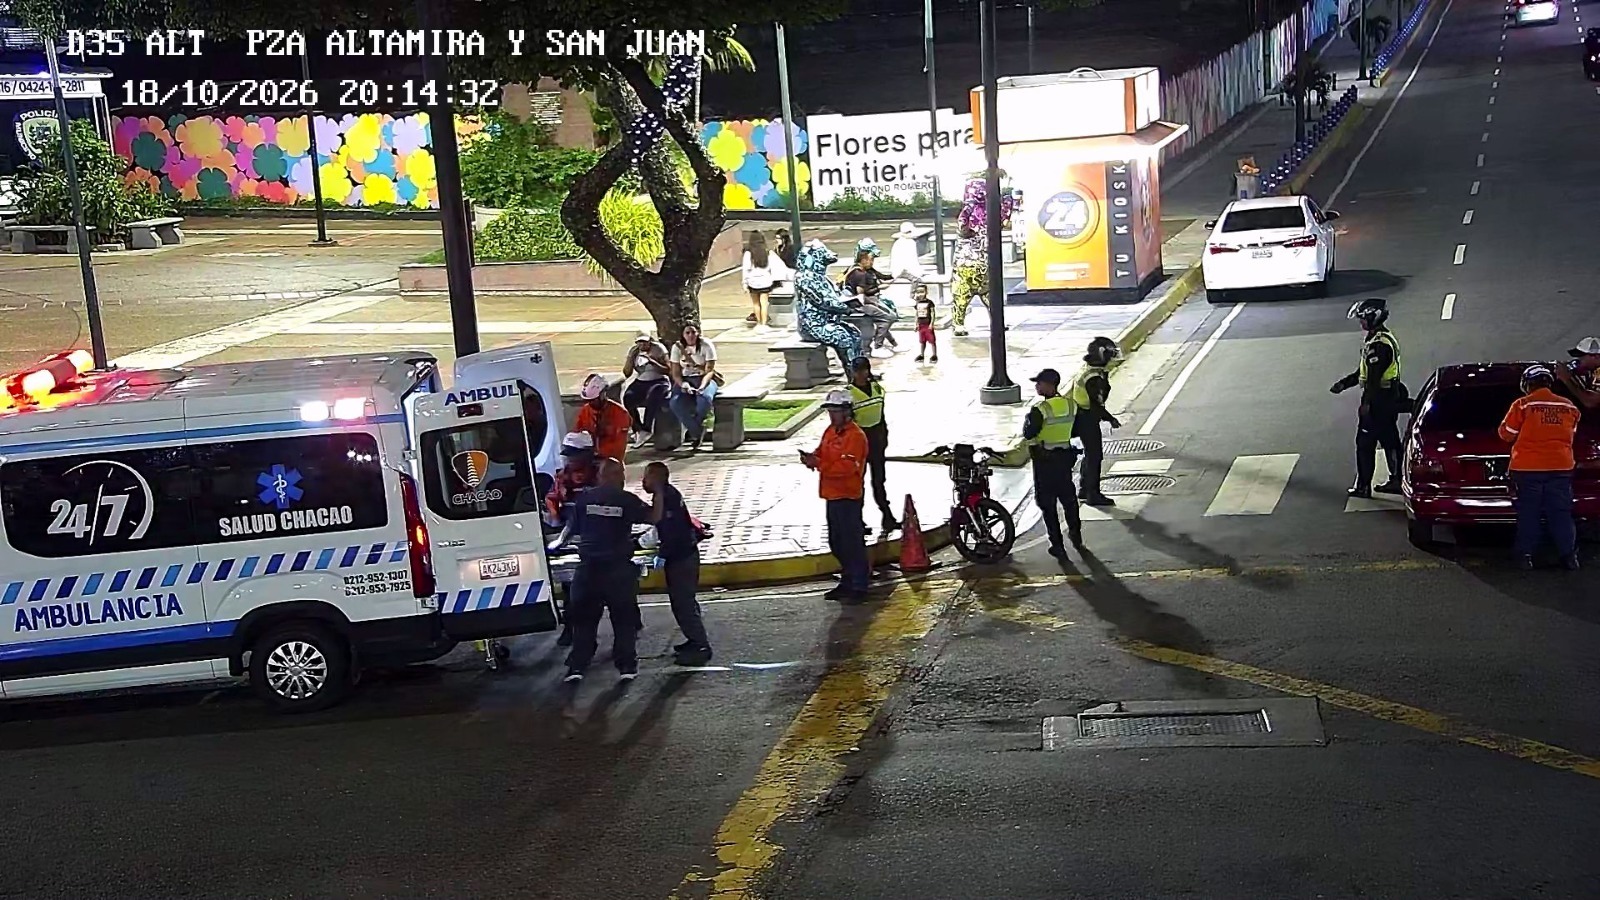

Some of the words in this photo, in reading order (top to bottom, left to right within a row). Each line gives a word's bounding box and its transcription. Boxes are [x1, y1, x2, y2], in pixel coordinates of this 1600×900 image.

[19, 80, 85, 93] 0424-1-2811
[816, 133, 907, 157] Flores
[818, 162, 851, 186] mi
[1115, 253, 1131, 278] TU
[444, 384, 520, 406] AMBUL
[452, 488, 503, 505] CHACAO
[47, 484, 130, 546] 24/7
[218, 513, 277, 536] SALUD
[280, 505, 353, 530] CHACAO
[15, 593, 183, 633] AMBULANCIA
